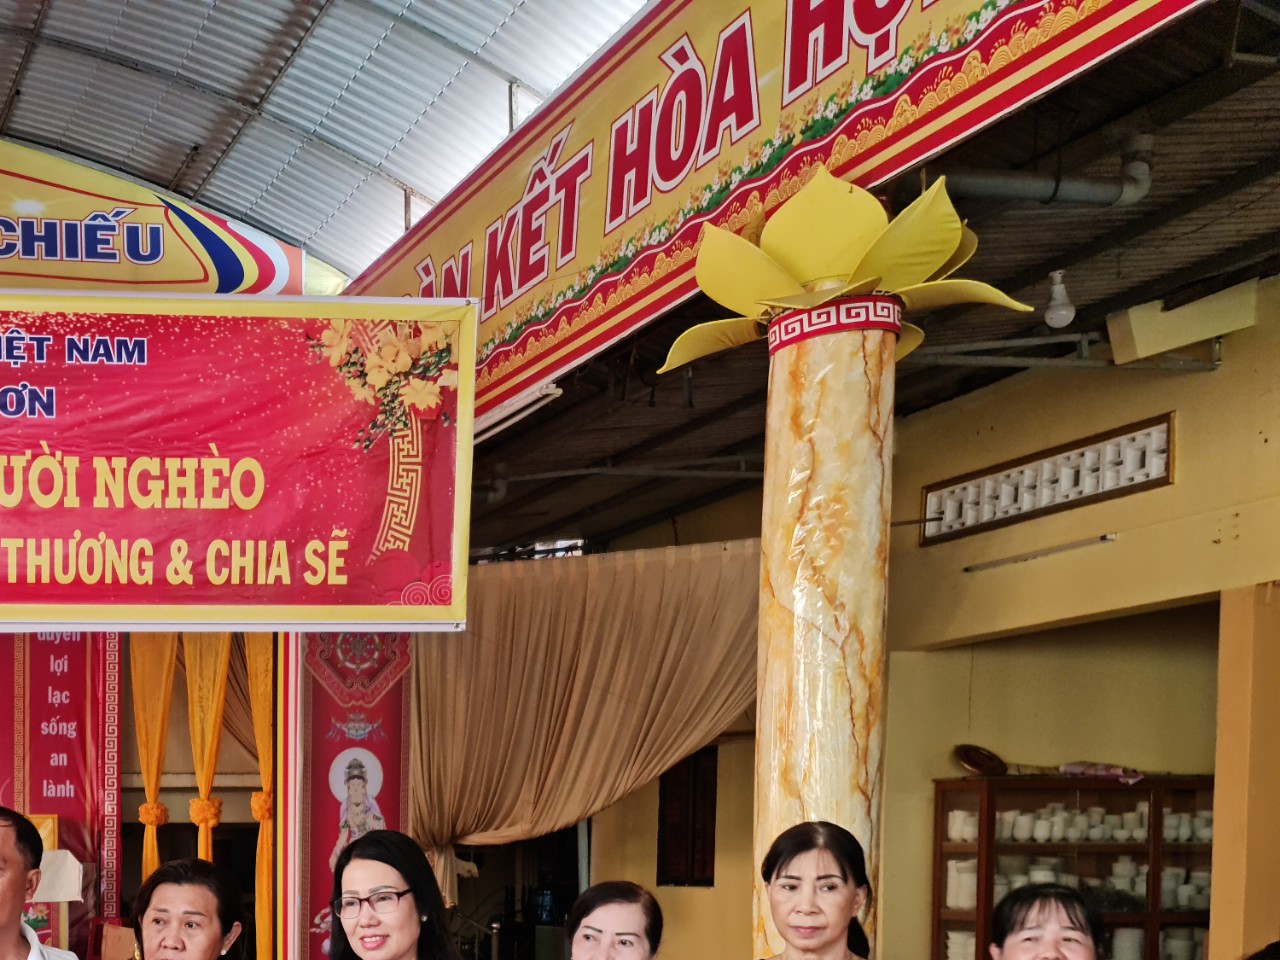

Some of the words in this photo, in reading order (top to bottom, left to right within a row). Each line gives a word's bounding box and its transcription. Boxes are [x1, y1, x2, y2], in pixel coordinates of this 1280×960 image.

[481, 118, 594, 325] KẾT
[604, 8, 761, 236] HÒA
[64, 336, 148, 366] NAM
[92, 443, 266, 511] NGHÈO
[0, 530, 155, 587] THƯƠNG
[166, 545, 194, 585] &
[205, 540, 291, 586] CHIA
[303, 524, 350, 586] SẼ
[49, 653, 70, 676] lợi
[47, 685, 70, 709] lạc
[40, 714, 78, 742] sống
[49, 751, 68, 768] an
[41, 777, 76, 799] lành
